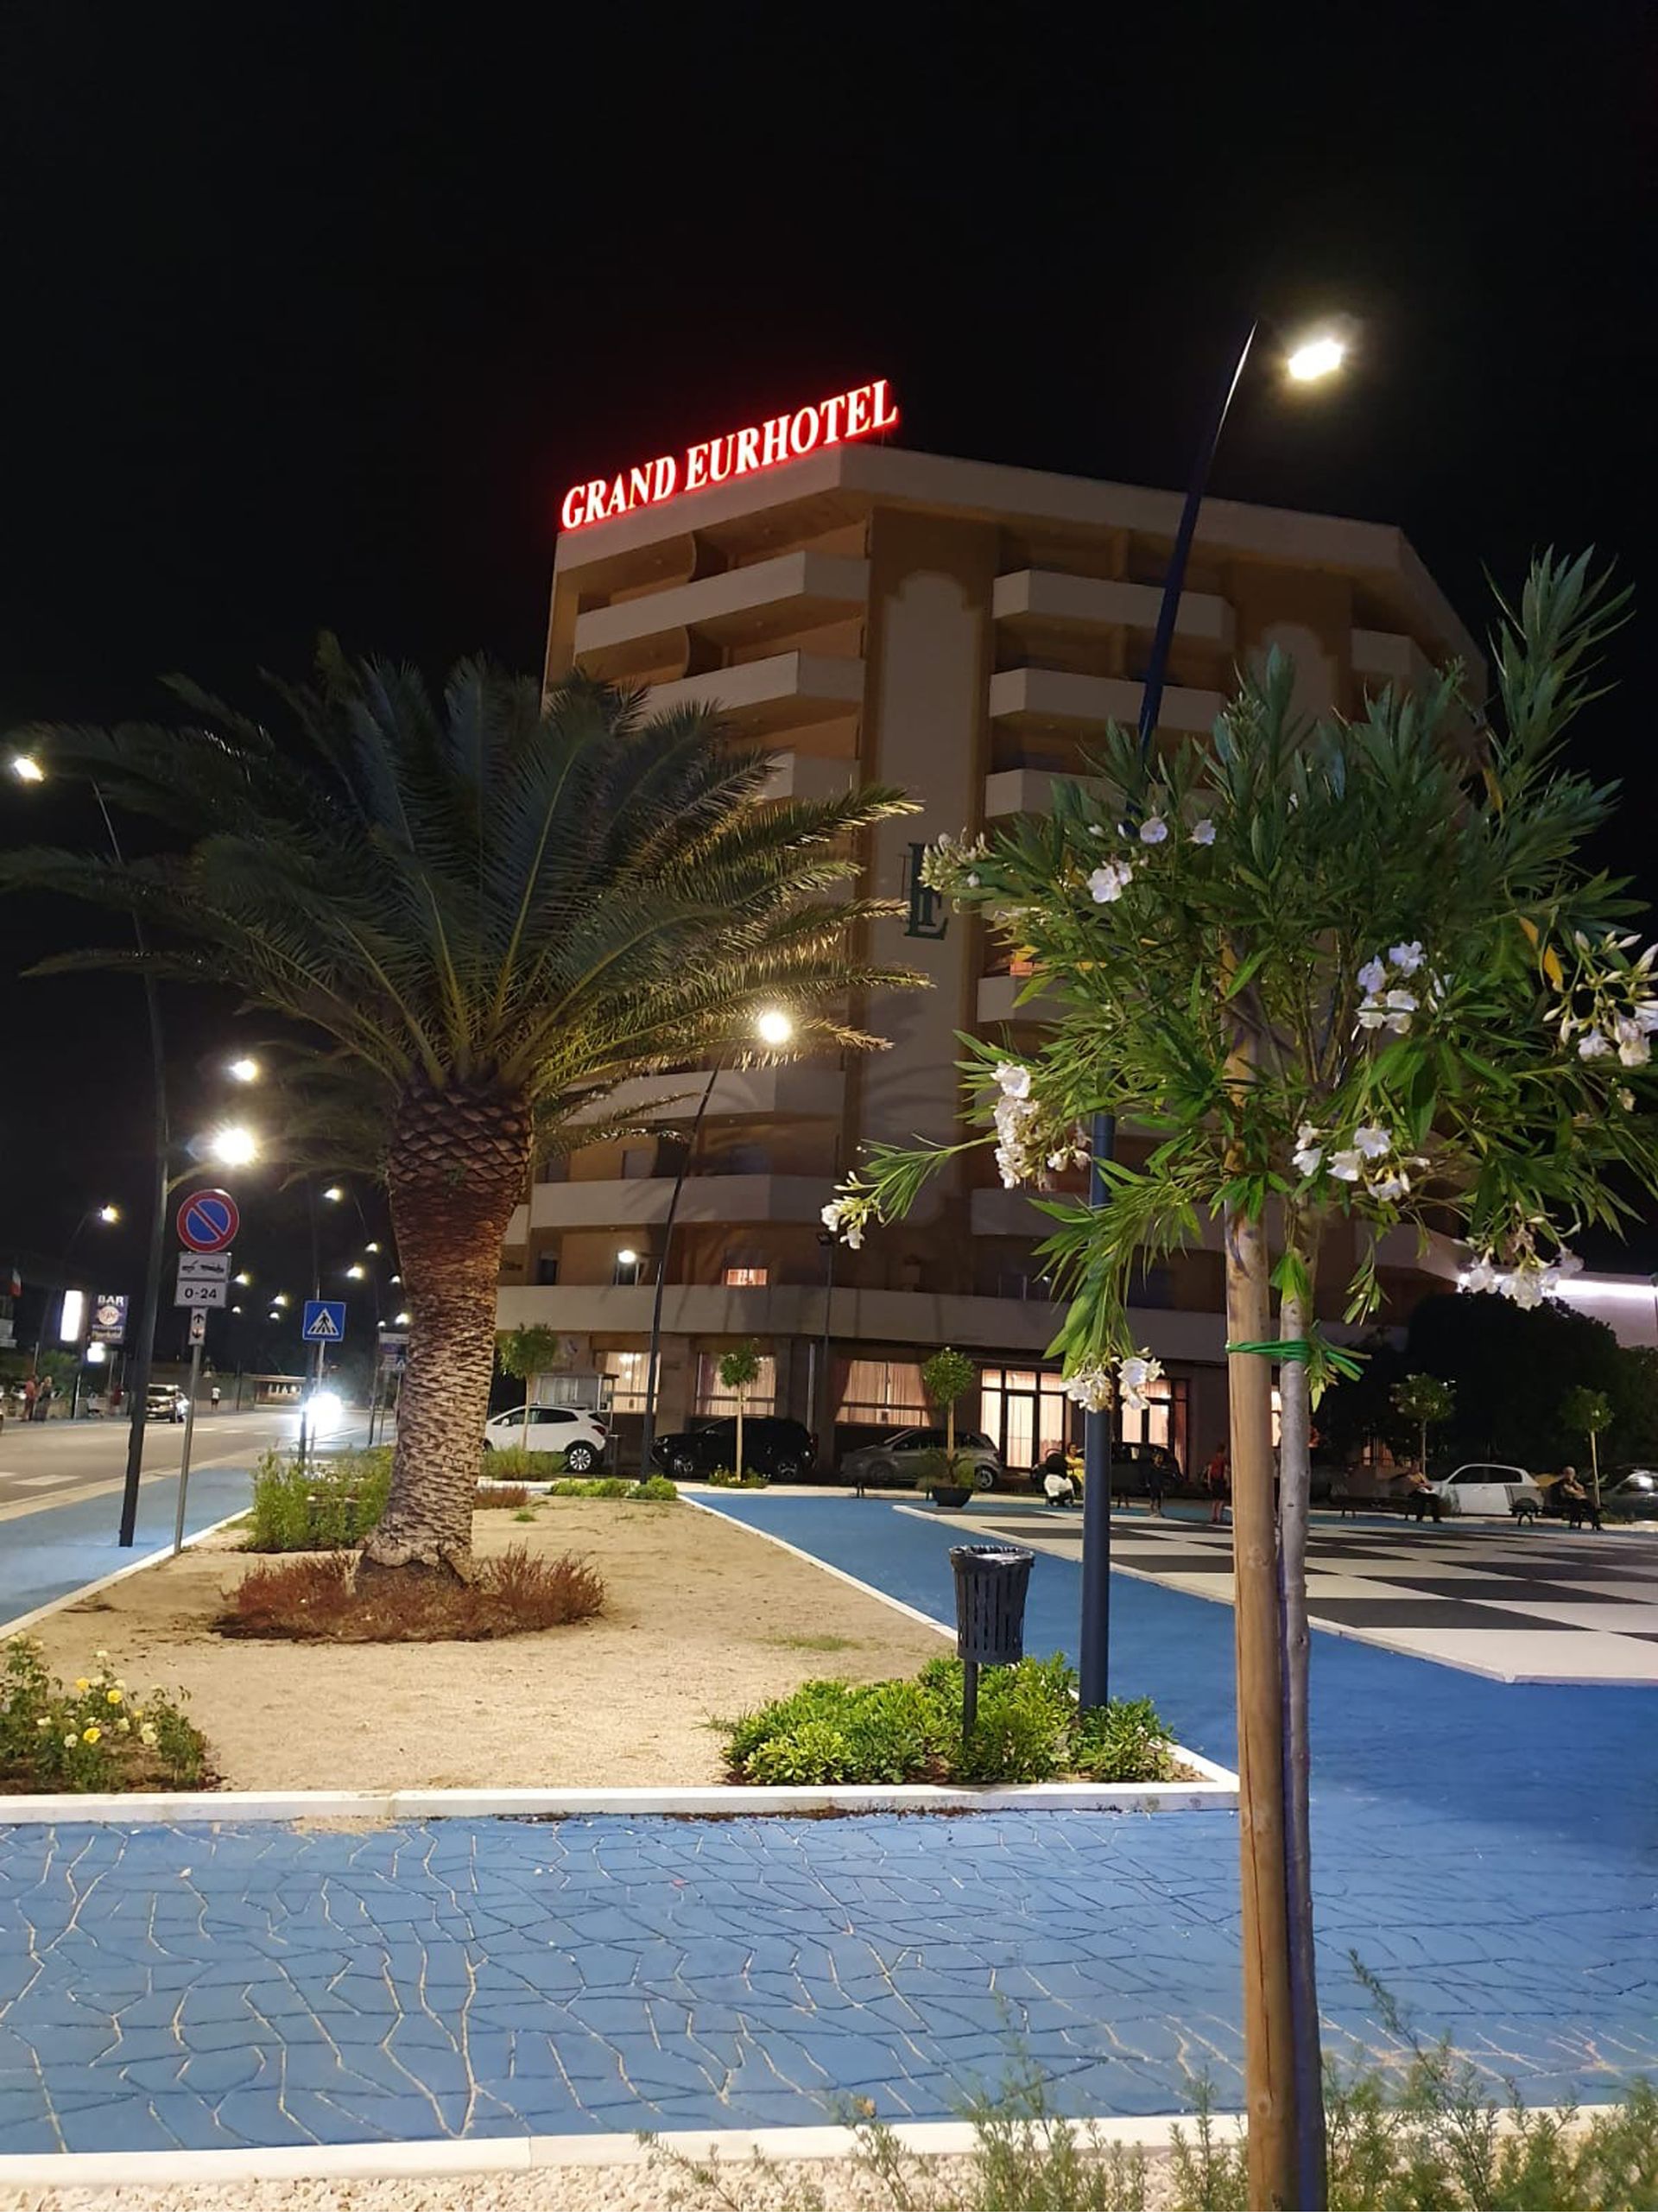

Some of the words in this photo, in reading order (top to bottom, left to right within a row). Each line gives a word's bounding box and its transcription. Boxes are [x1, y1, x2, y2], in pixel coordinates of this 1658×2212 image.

[561, 456, 676, 529] GRAND
[685, 379, 898, 491] EURHOTEL
[184, 1288, 217, 1299] 0-24
[98, 1295, 124, 1307] BAR
